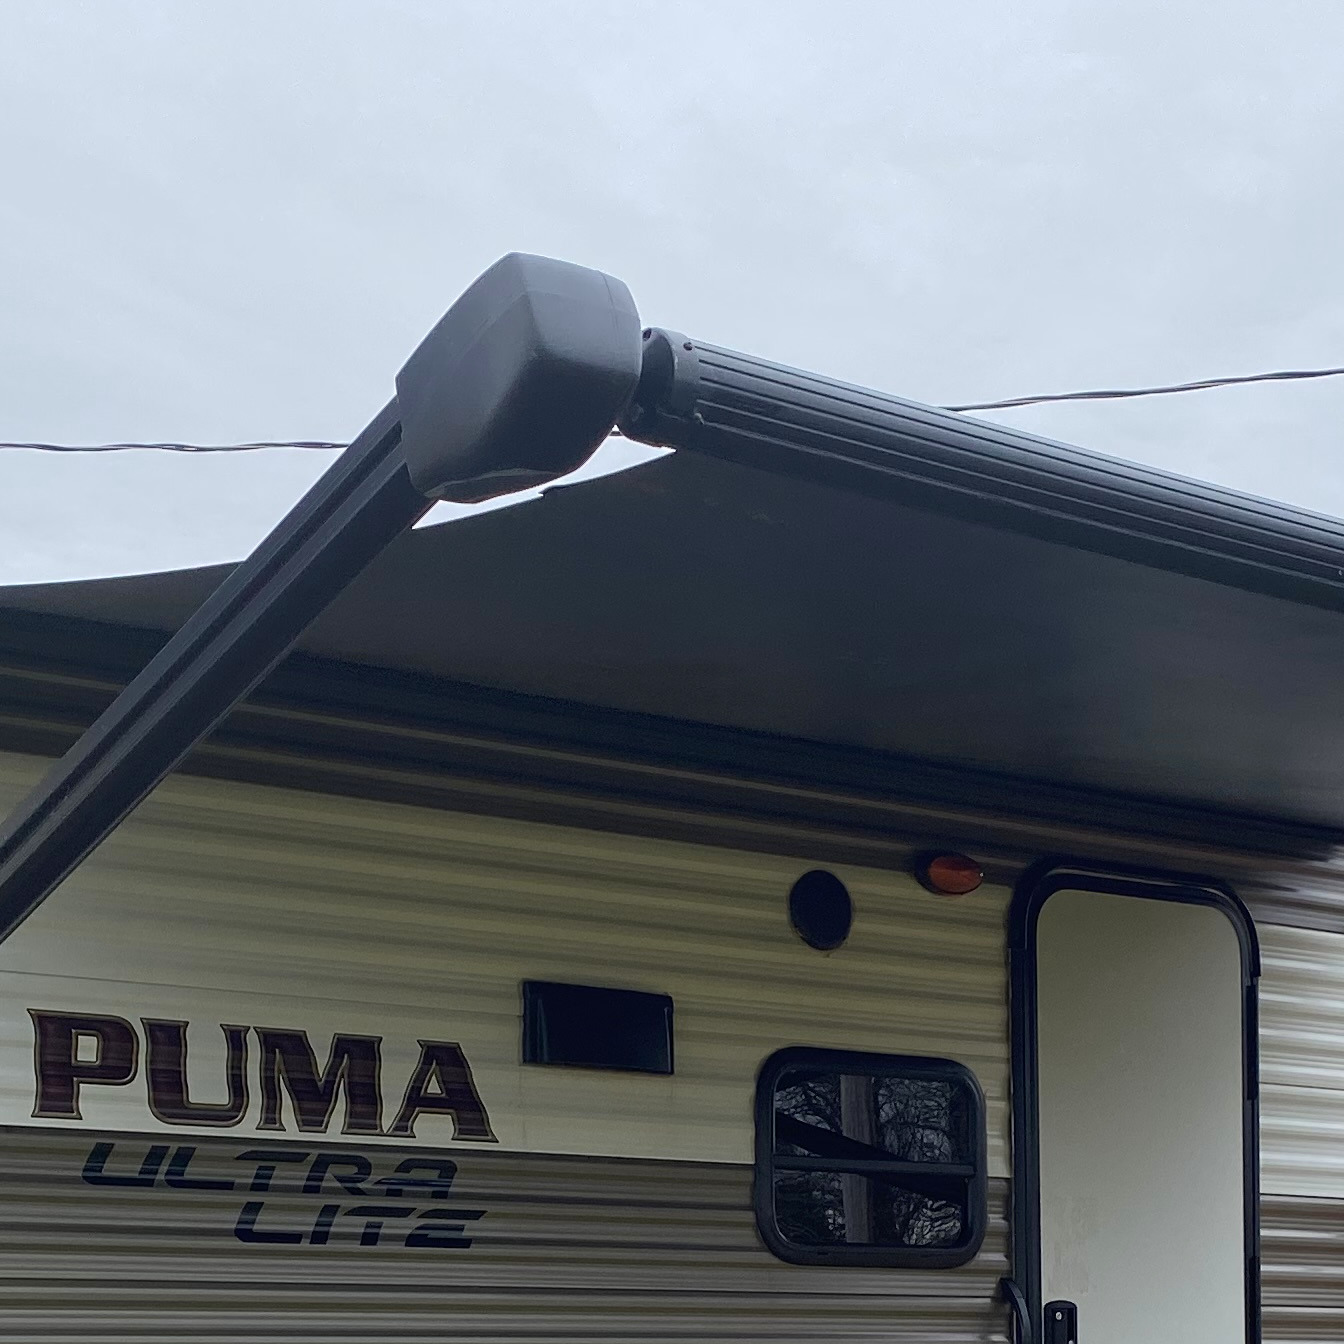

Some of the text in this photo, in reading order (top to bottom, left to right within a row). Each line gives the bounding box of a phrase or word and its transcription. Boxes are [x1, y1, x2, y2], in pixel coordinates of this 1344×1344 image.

[27, 1008, 500, 1143] PUMA
[81, 1142, 459, 1199] ULTRA
[233, 1201, 488, 1250] LITE
